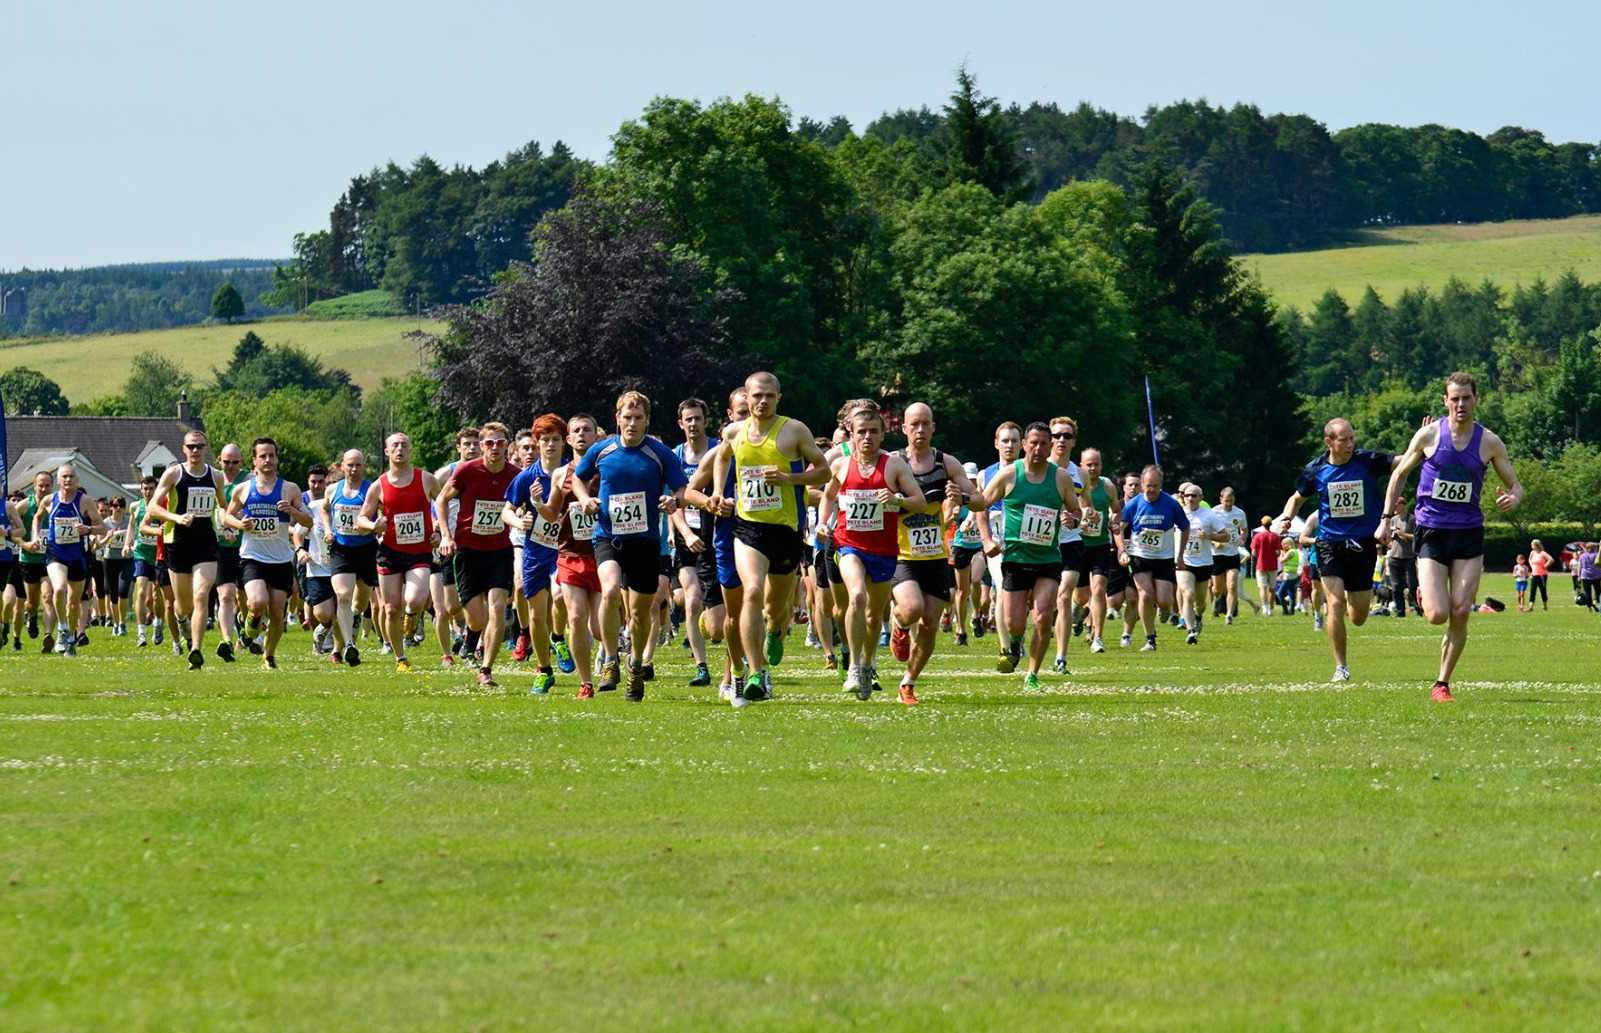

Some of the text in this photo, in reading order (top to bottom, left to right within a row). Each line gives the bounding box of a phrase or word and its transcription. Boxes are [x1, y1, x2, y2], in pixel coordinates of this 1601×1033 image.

[746, 480, 775, 498] 210
[1437, 482, 1467, 501] 268
[192, 496, 210, 509] 111
[624, 494, 644, 503] BLAND
[1333, 492, 1360, 508] 282
[477, 510, 502, 526] 257
[614, 504, 642, 523] 254
[850, 502, 879, 520] 227
[252, 518, 276, 531] 208
[340, 513, 354, 527] 94
[627, 520, 646, 529] BLAND
[1028, 517, 1052, 535] 112
[60, 525, 74, 537] 72
[398, 521, 421, 535] 204
[543, 522, 559, 537] 98
[912, 528, 938, 546] 237
[1141, 533, 1160, 546] 265
[1188, 541, 1200, 551] 74
